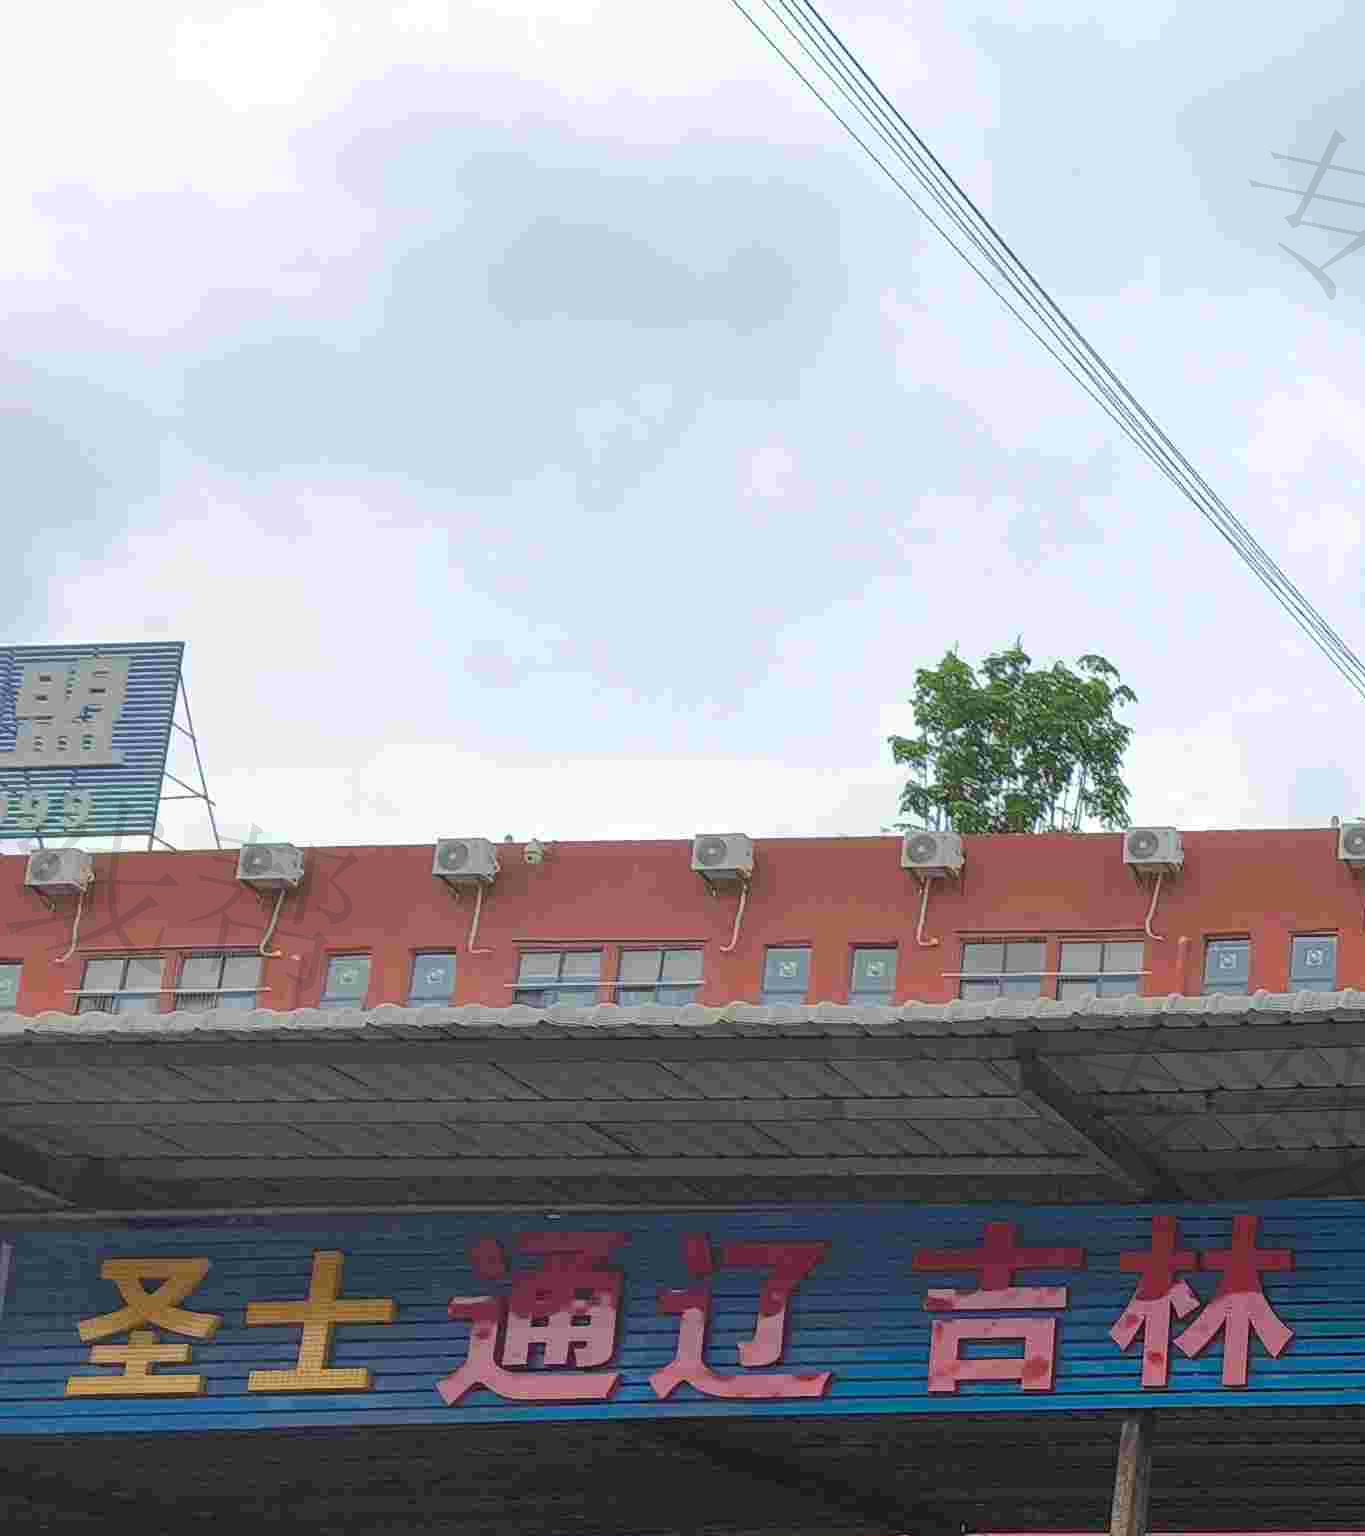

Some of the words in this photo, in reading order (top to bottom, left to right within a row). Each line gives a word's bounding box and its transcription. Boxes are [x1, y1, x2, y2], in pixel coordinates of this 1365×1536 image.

[65, 1249, 396, 1397] 圣士
[436, 1232, 834, 1406] 通辽
[911, 1214, 1296, 1394] 吉林
